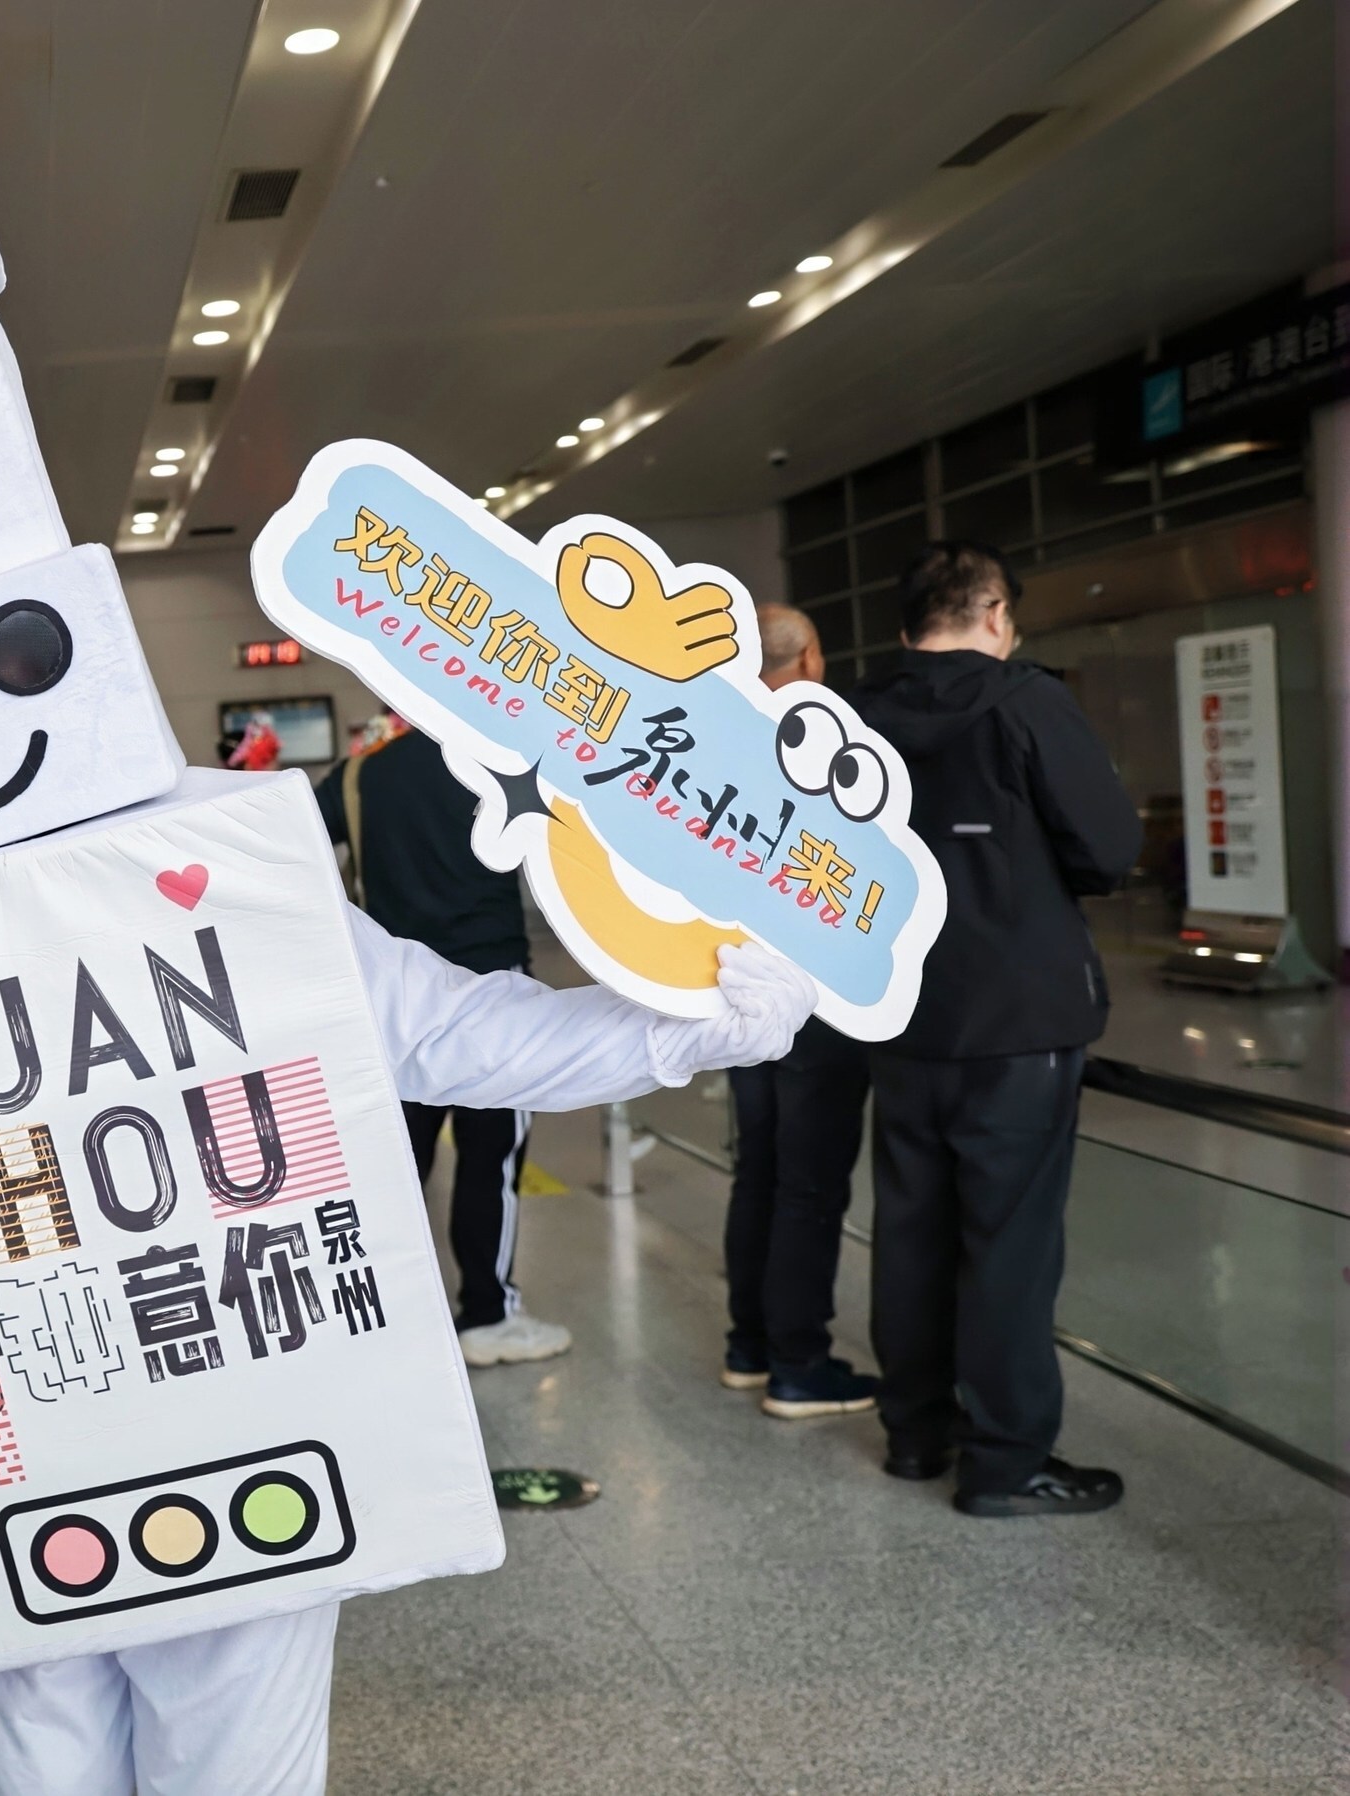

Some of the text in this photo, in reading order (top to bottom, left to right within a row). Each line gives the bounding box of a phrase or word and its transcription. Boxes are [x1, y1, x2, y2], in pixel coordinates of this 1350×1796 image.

[335, 577, 526, 719] Welcome
[556, 727, 598, 765] to
[314, 1199, 387, 1336] 泉州
